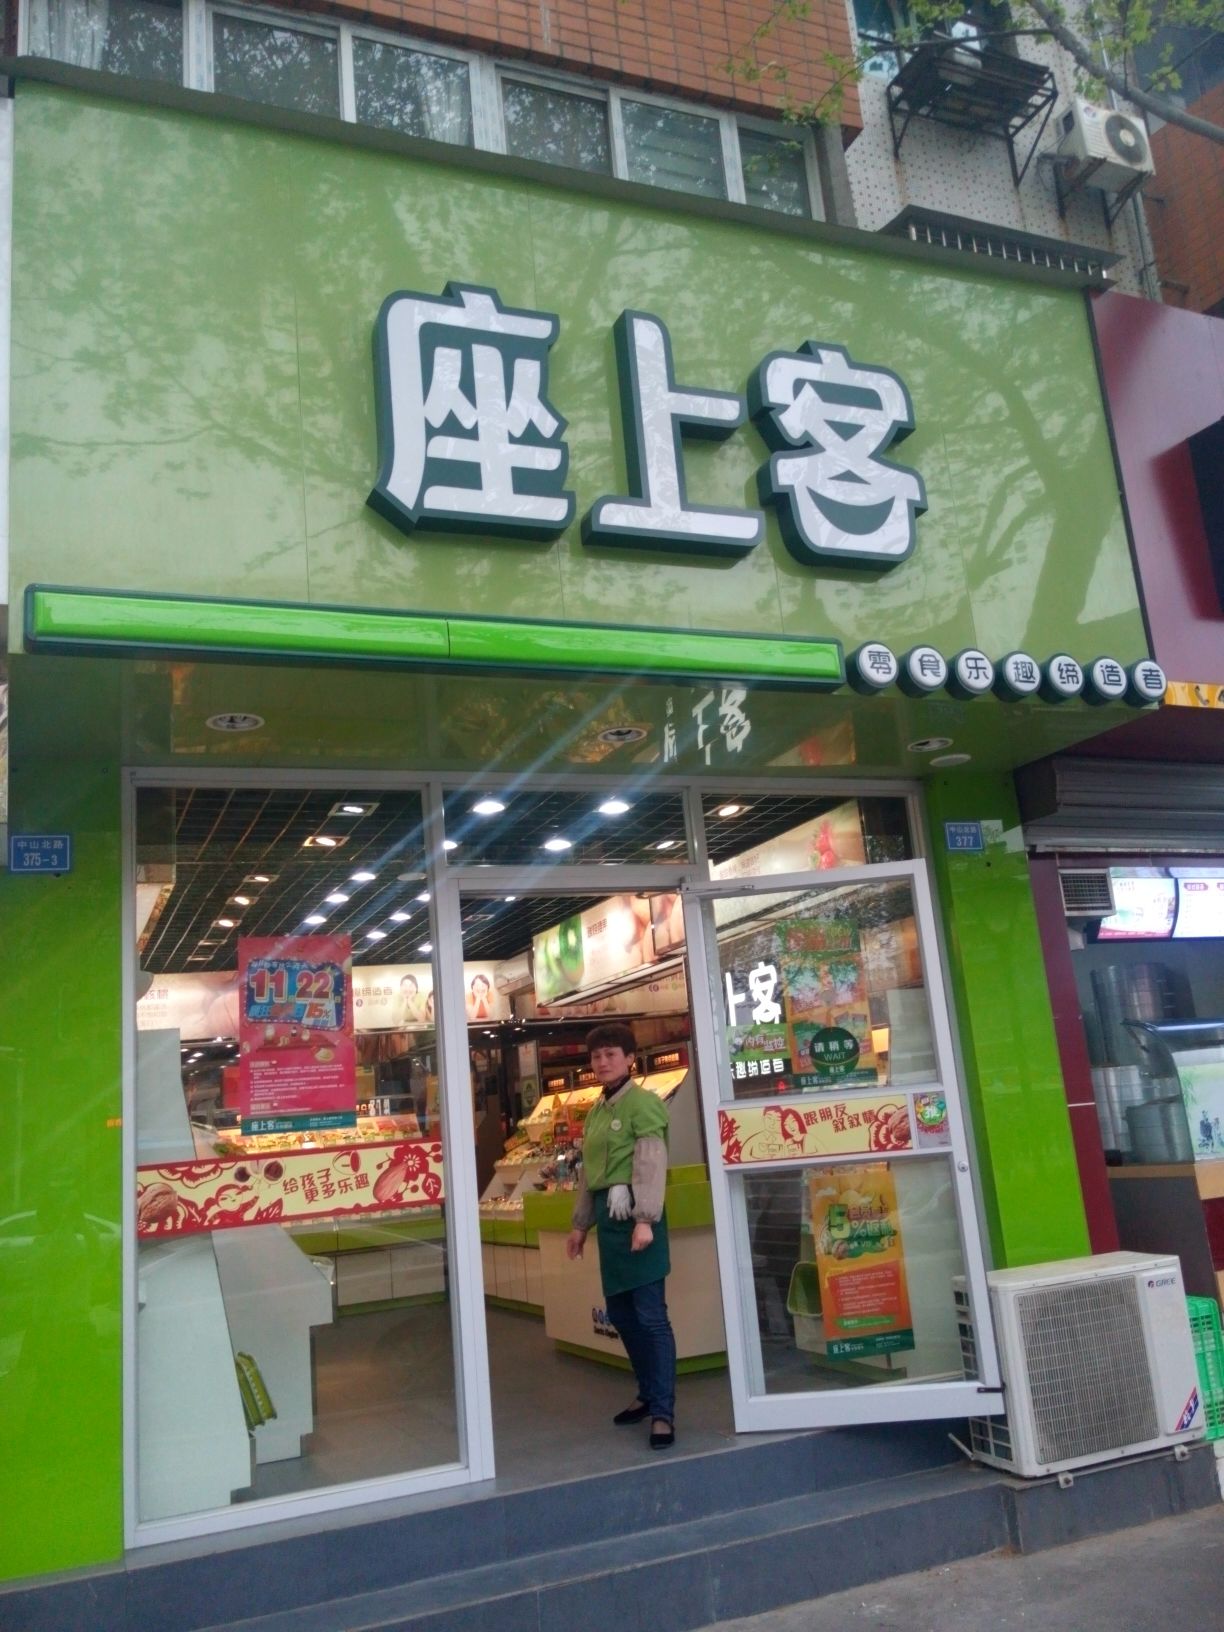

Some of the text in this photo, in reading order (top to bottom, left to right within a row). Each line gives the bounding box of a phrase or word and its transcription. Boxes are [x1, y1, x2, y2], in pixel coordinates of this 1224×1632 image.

[376, 283, 926, 562] 座上客
[867, 649, 1165, 690] 零食乐趣缔造者
[17, 840, 64, 849] 中山北路
[955, 836, 974, 847] 377
[814, 1039, 855, 1053] 请稍等
[824, 1051, 847, 1061] WAIT
[803, 1103, 849, 1126] 跟朋友
[282, 1167, 332, 1195] 给孩子
[303, 1172, 370, 1204] 更多乐趣
